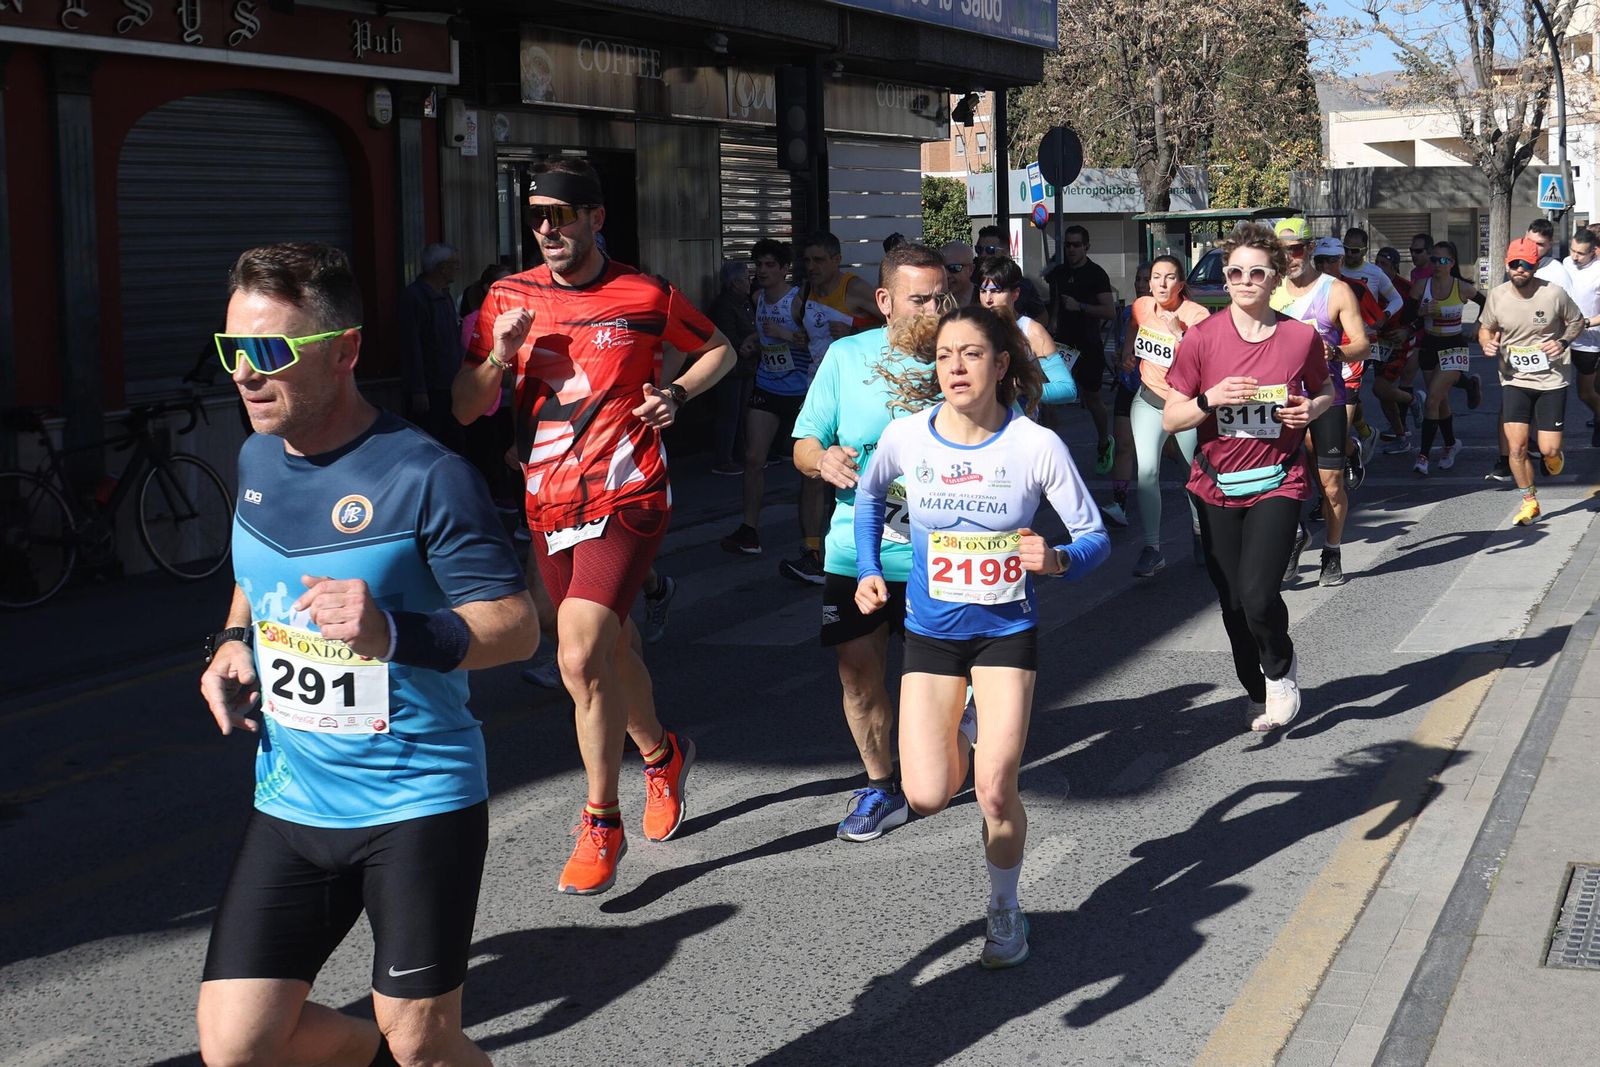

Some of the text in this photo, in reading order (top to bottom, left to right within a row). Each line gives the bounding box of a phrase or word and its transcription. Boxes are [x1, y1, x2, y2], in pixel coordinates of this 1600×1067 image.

[352, 19, 402, 58] Pub
[576, 38, 663, 80] COFFEE
[1136, 337, 1172, 359] 3068
[1440, 355, 1469, 366] 2108
[1513, 354, 1540, 366] 396
[951, 461, 972, 478] 35
[919, 497, 1008, 515] MARACENA
[943, 535, 958, 548] 38
[958, 540, 1008, 551] FONDO
[931, 555, 1023, 587] 2198
[289, 637, 353, 661] FONDO
[271, 658, 356, 708] 291
